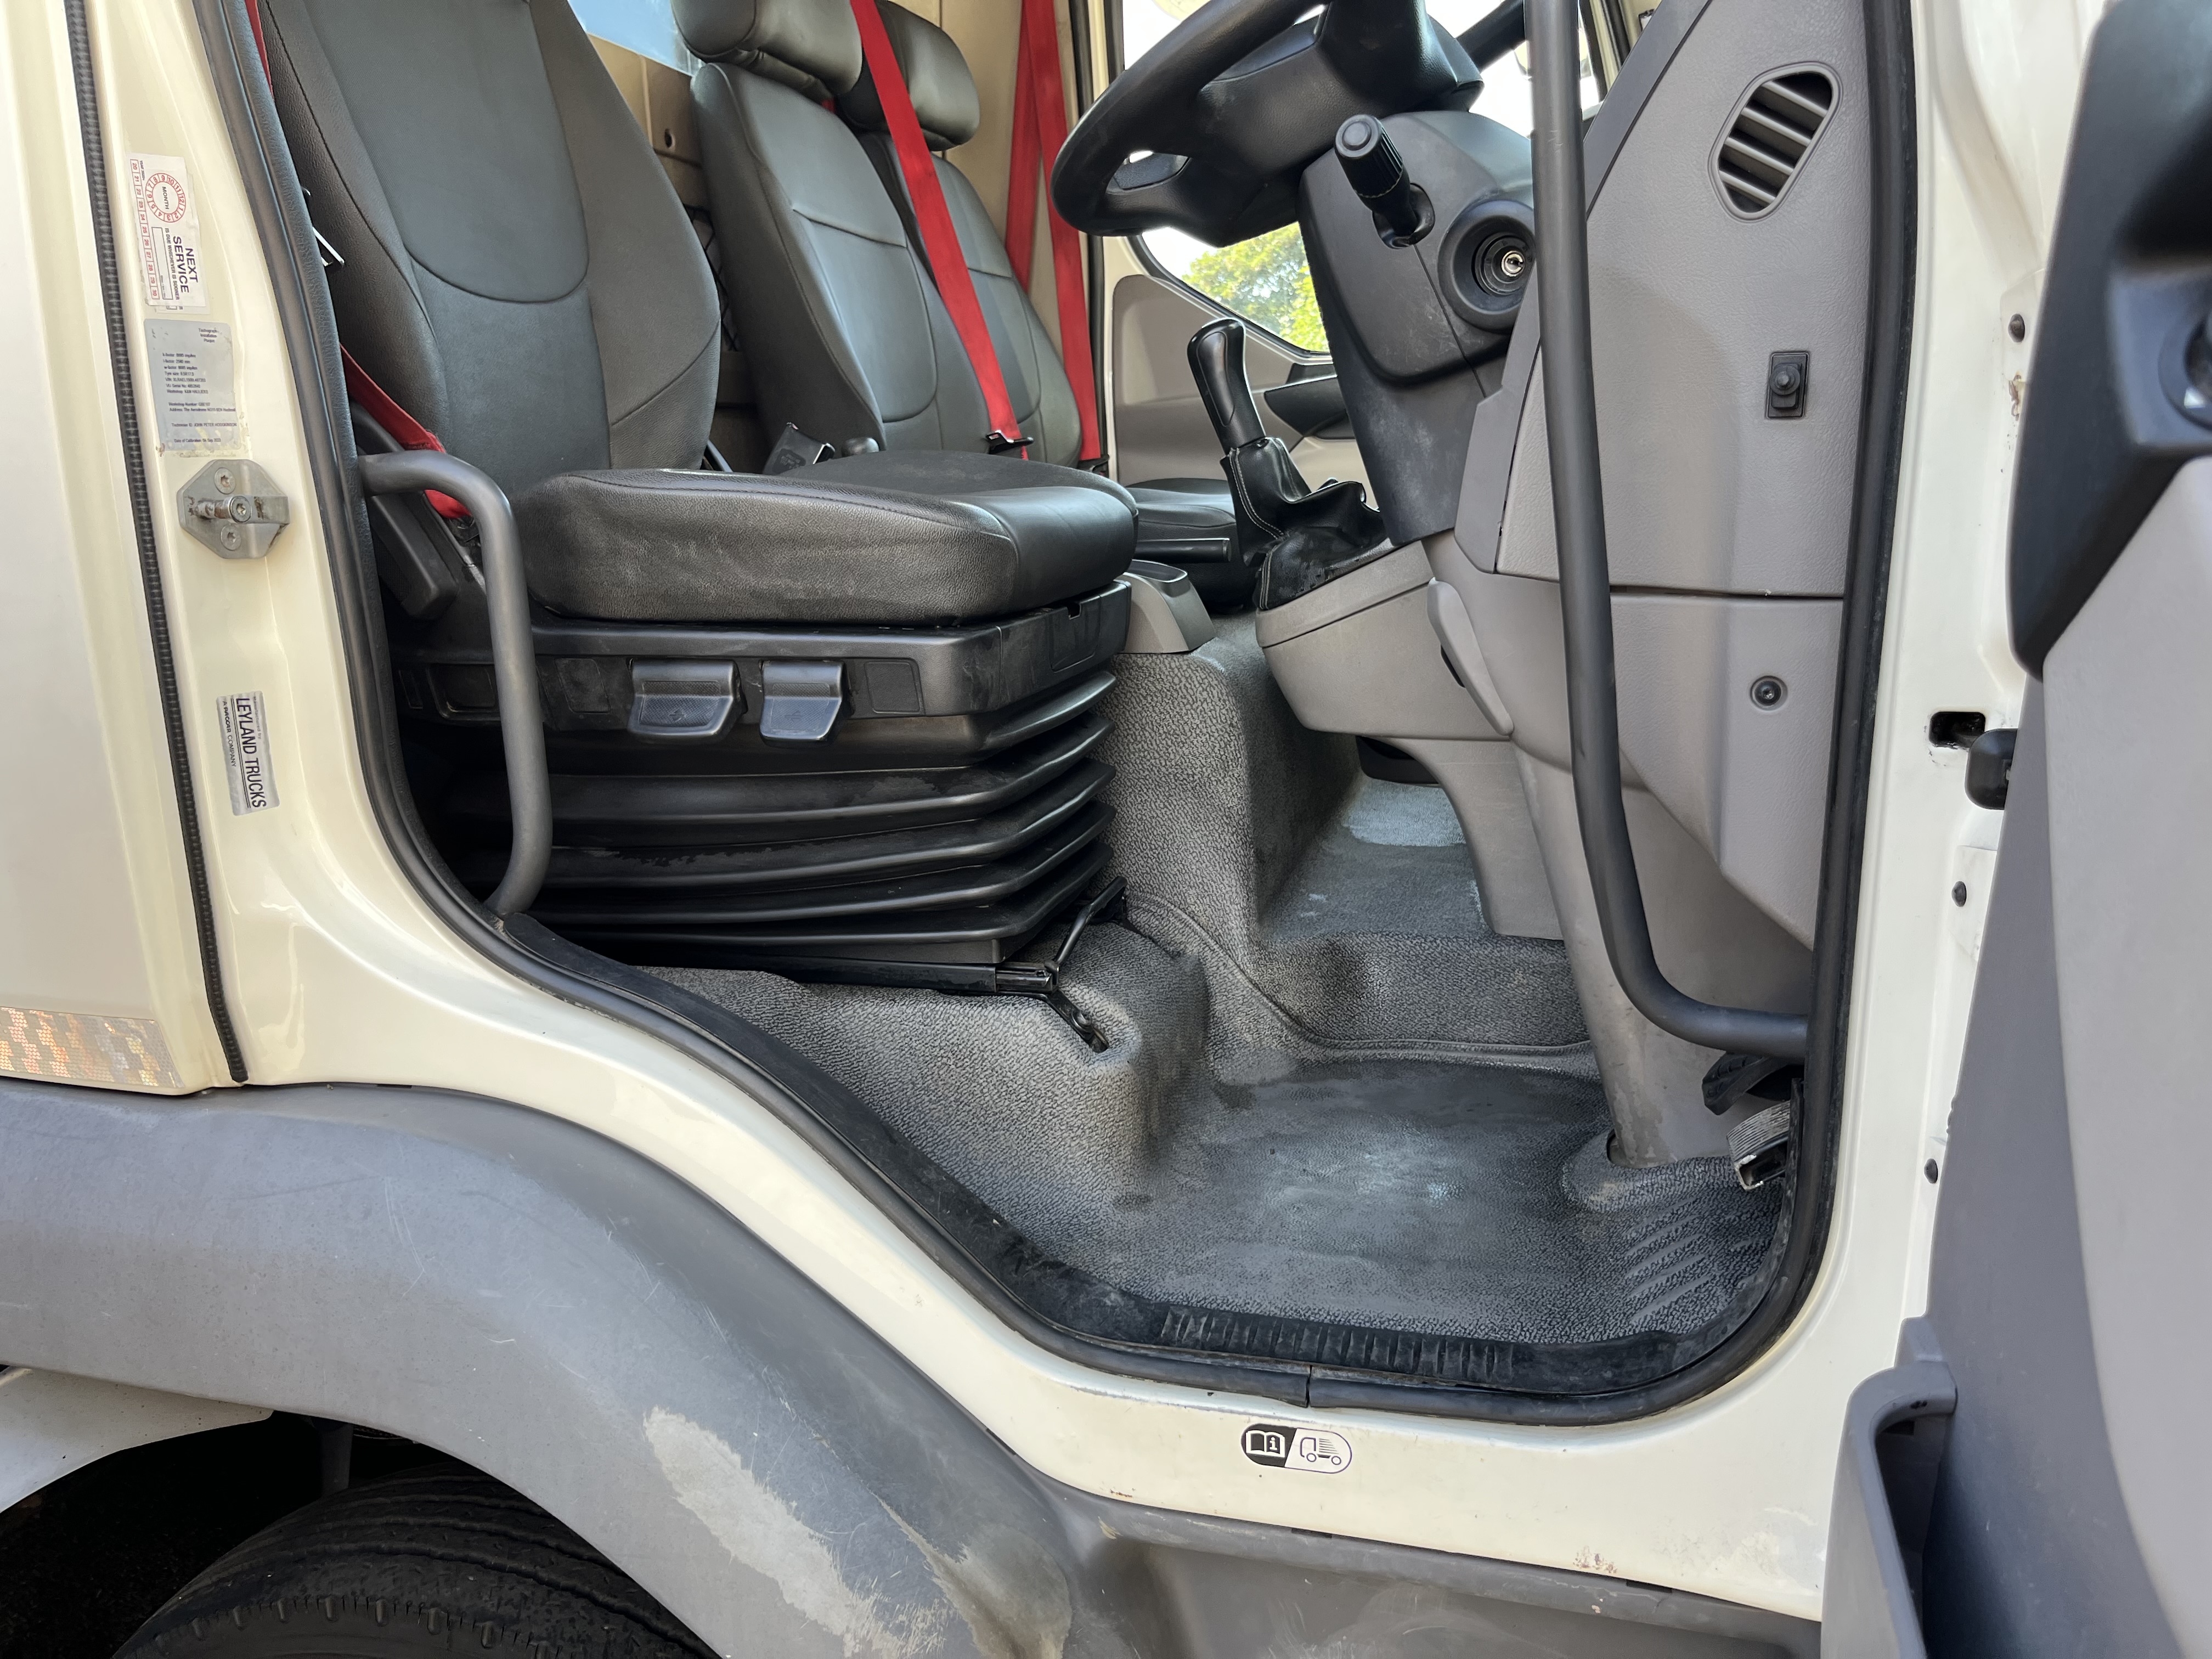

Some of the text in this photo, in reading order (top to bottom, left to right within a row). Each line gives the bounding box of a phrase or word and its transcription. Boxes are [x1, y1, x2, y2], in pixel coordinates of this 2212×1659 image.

[167, 245, 176, 273] WHICHEVER
[173, 236, 189, 293] SERVICE
[185, 247, 198, 283] NEXT
[223, 707, 232, 733] PACCAR
[227, 735, 236, 767] COMPANY
[236, 698, 267, 808] LEYLAND TRUCKS
